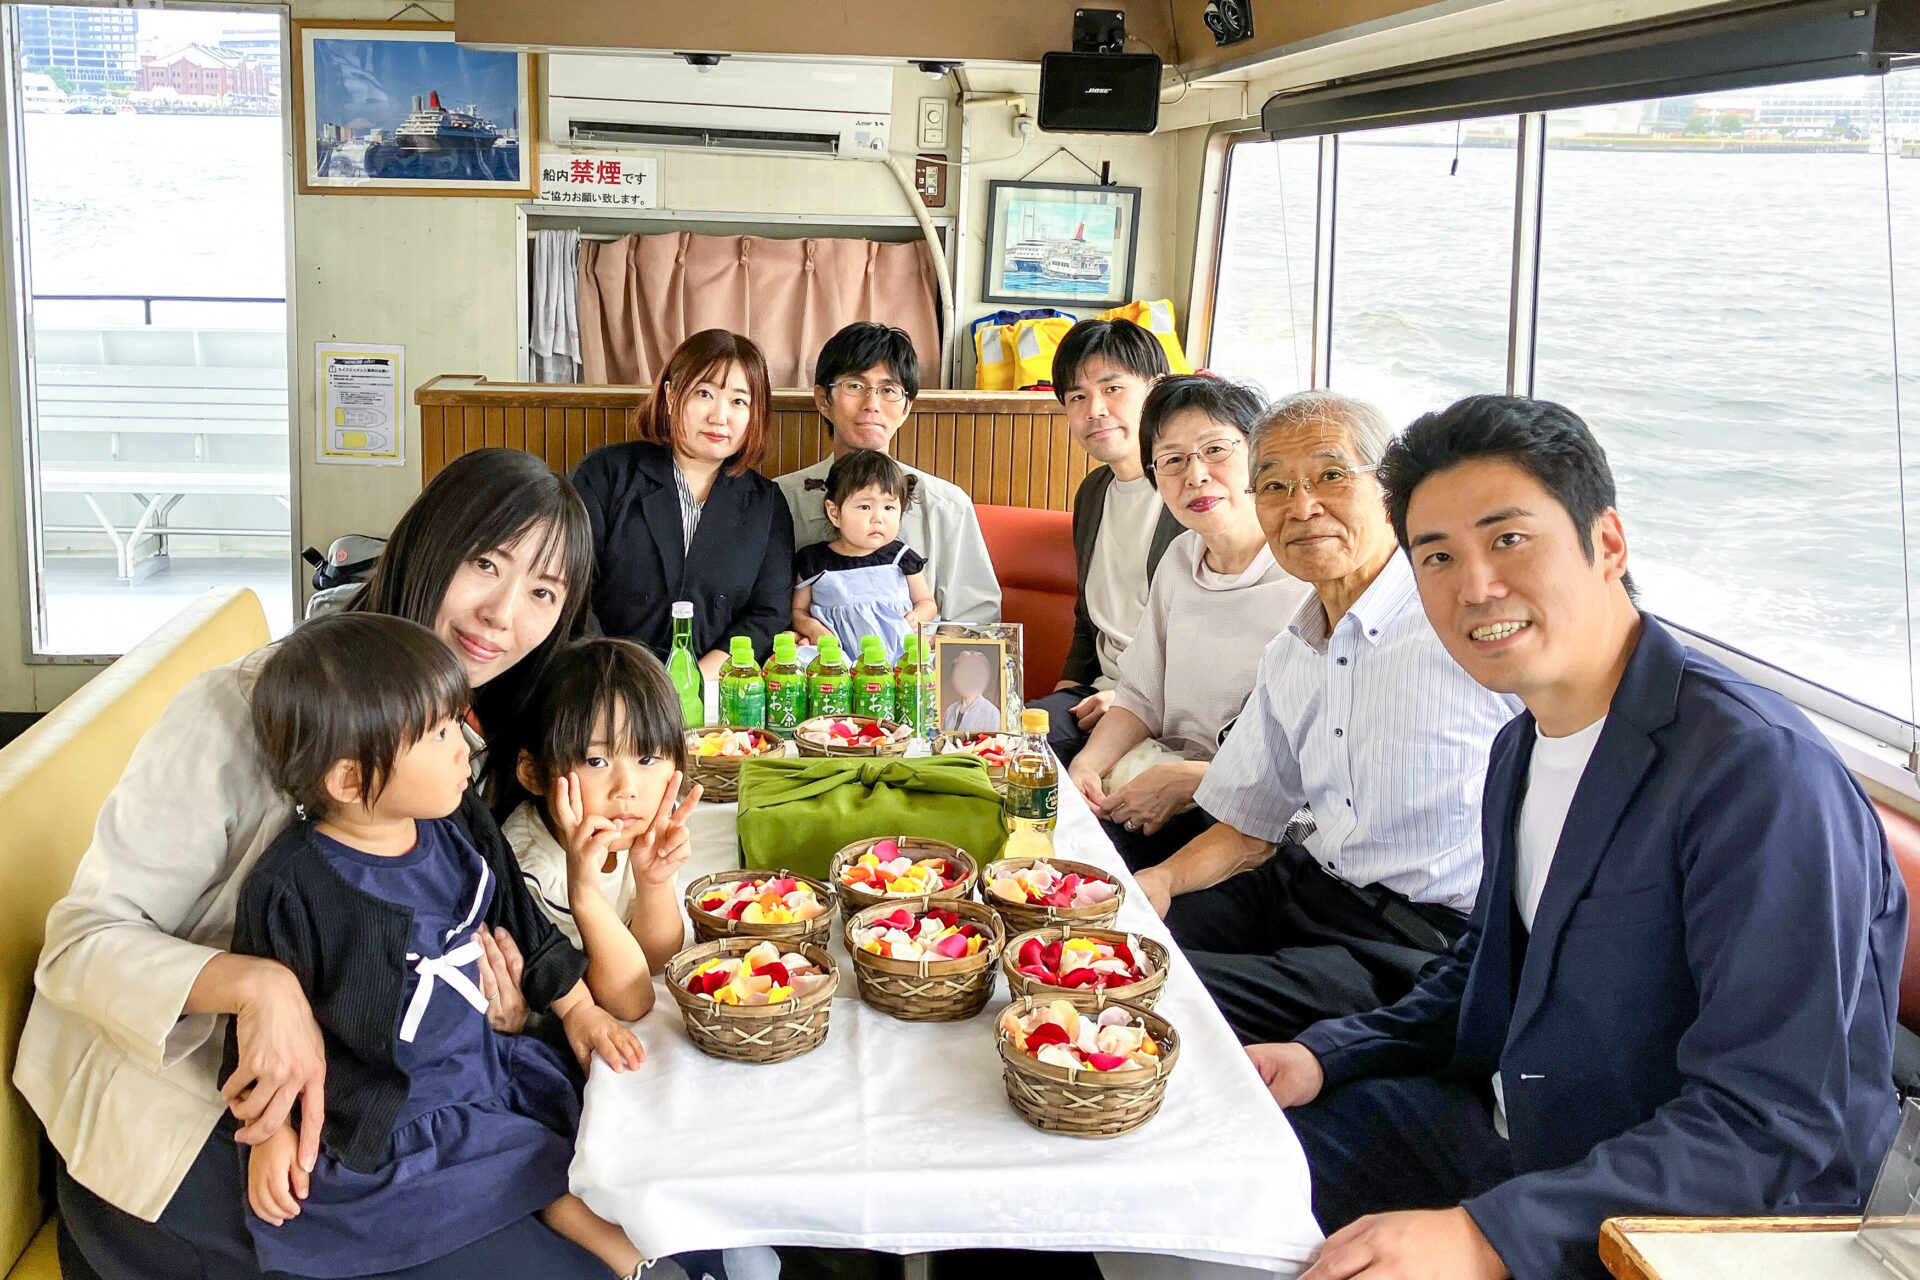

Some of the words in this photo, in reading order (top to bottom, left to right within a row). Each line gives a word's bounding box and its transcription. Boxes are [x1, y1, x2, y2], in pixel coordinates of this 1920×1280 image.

[542, 159, 647, 185] 船内禁煙です
[541, 190, 645, 205] ご協力お願い致します。
